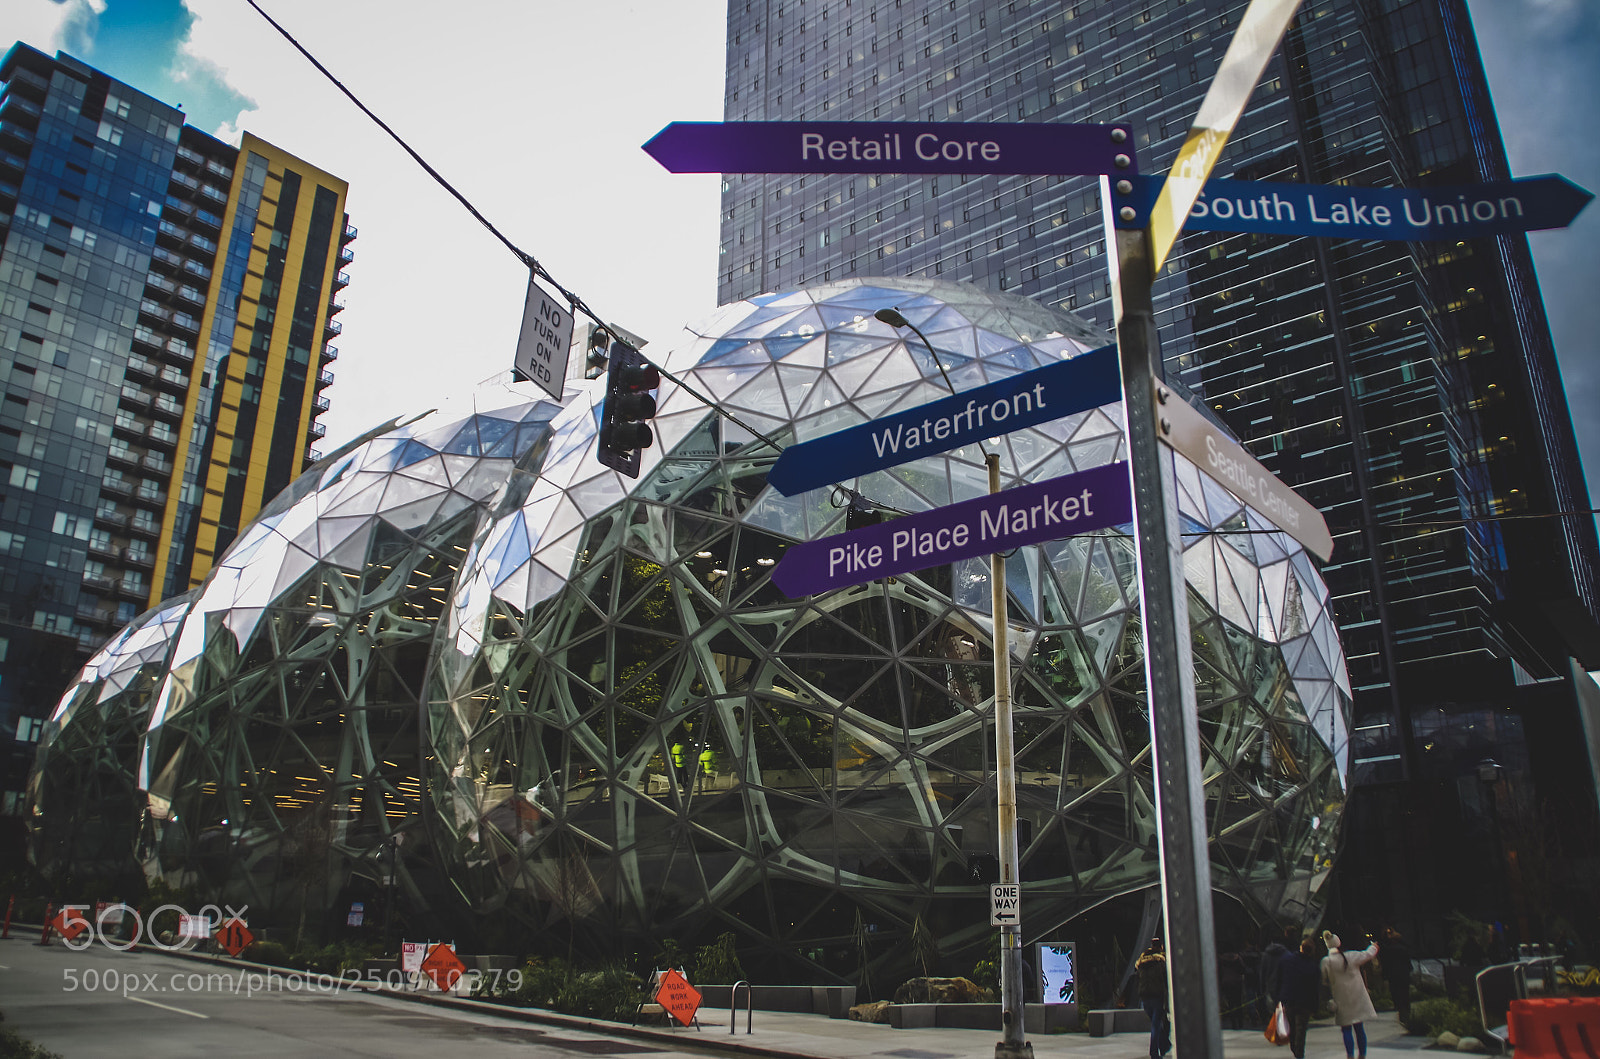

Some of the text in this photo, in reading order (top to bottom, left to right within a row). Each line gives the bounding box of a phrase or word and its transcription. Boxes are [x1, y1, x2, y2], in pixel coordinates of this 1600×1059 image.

[802, 133, 1001, 162] Retail Core
[1189, 191, 1524, 227] South Lake Union
[540, 299, 561, 328] NO
[534, 317, 561, 350] TURN
[536, 342, 551, 364] ON
[529, 357, 551, 383] RED
[872, 382, 1046, 458] Waterfront
[1205, 434, 1300, 529] Seattle Center
[829, 488, 1094, 577] Pike Place Market
[994, 887, 1017, 898] ONE
[994, 899, 1018, 909] WAY
[670, 993, 688, 1001] WORK
[671, 1003, 694, 1011] AHEAD
